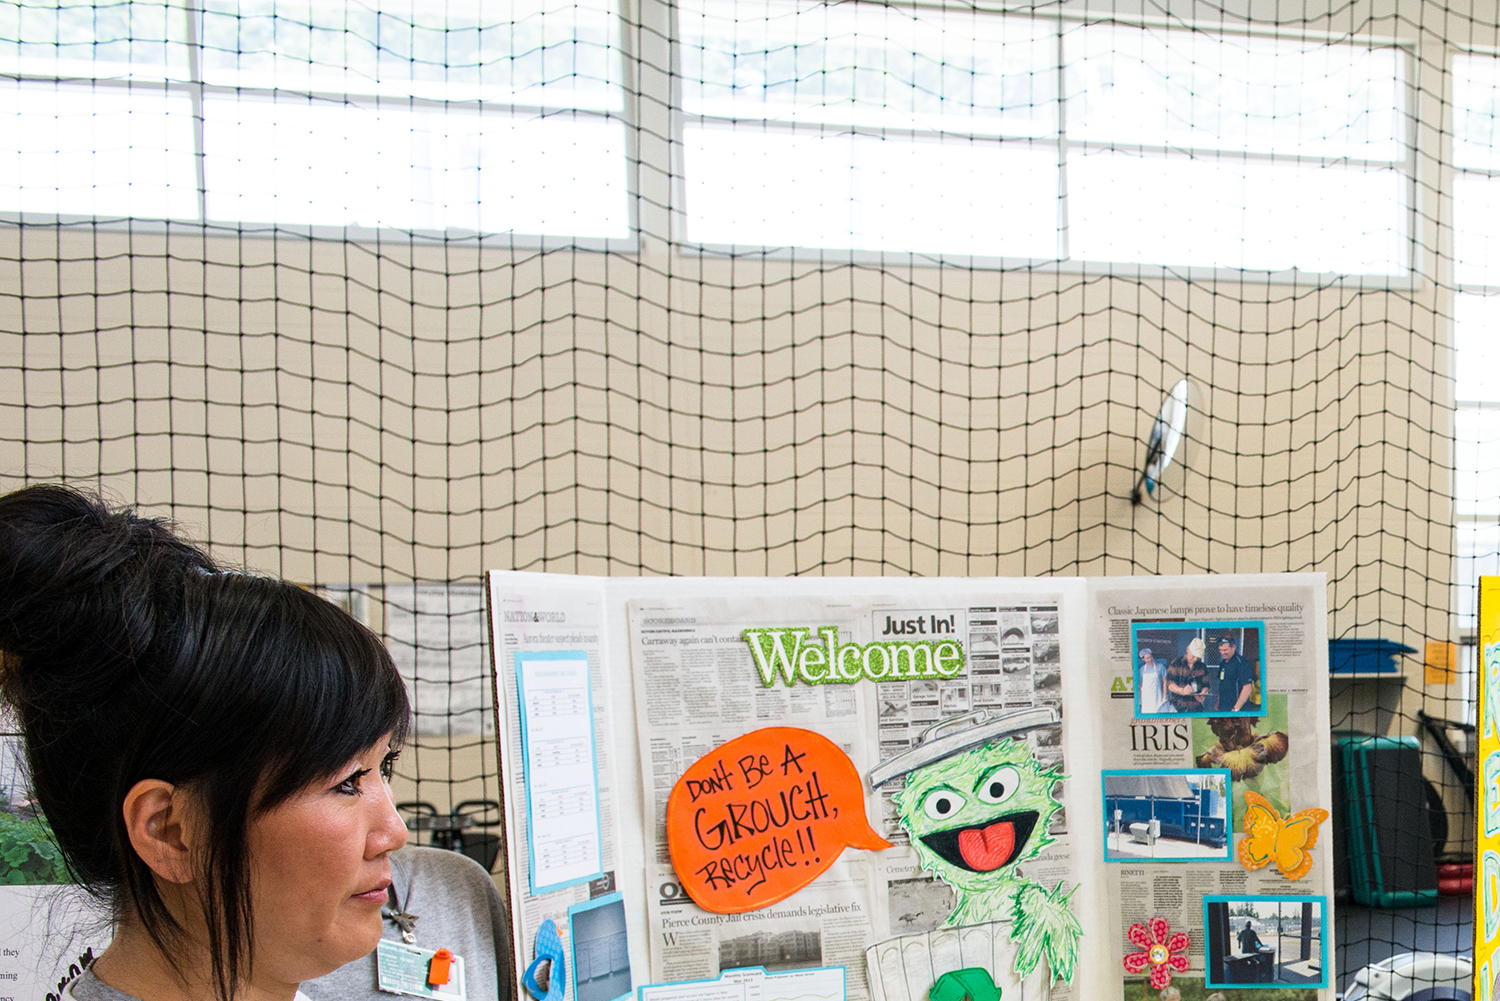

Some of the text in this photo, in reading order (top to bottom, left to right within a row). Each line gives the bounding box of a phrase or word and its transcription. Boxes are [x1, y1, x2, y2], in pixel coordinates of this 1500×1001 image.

[882, 614, 955, 636] Just In!
[718, 635, 745, 643] contai
[745, 628, 962, 685] Welcome
[1129, 724, 1189, 751] IRIS
[780, 744, 806, 776] A
[694, 771, 838, 851] GROUCH,
[662, 902, 862, 928] Pierce County Jail crisis demands legislative fix
[3, 948, 20, 958] they
